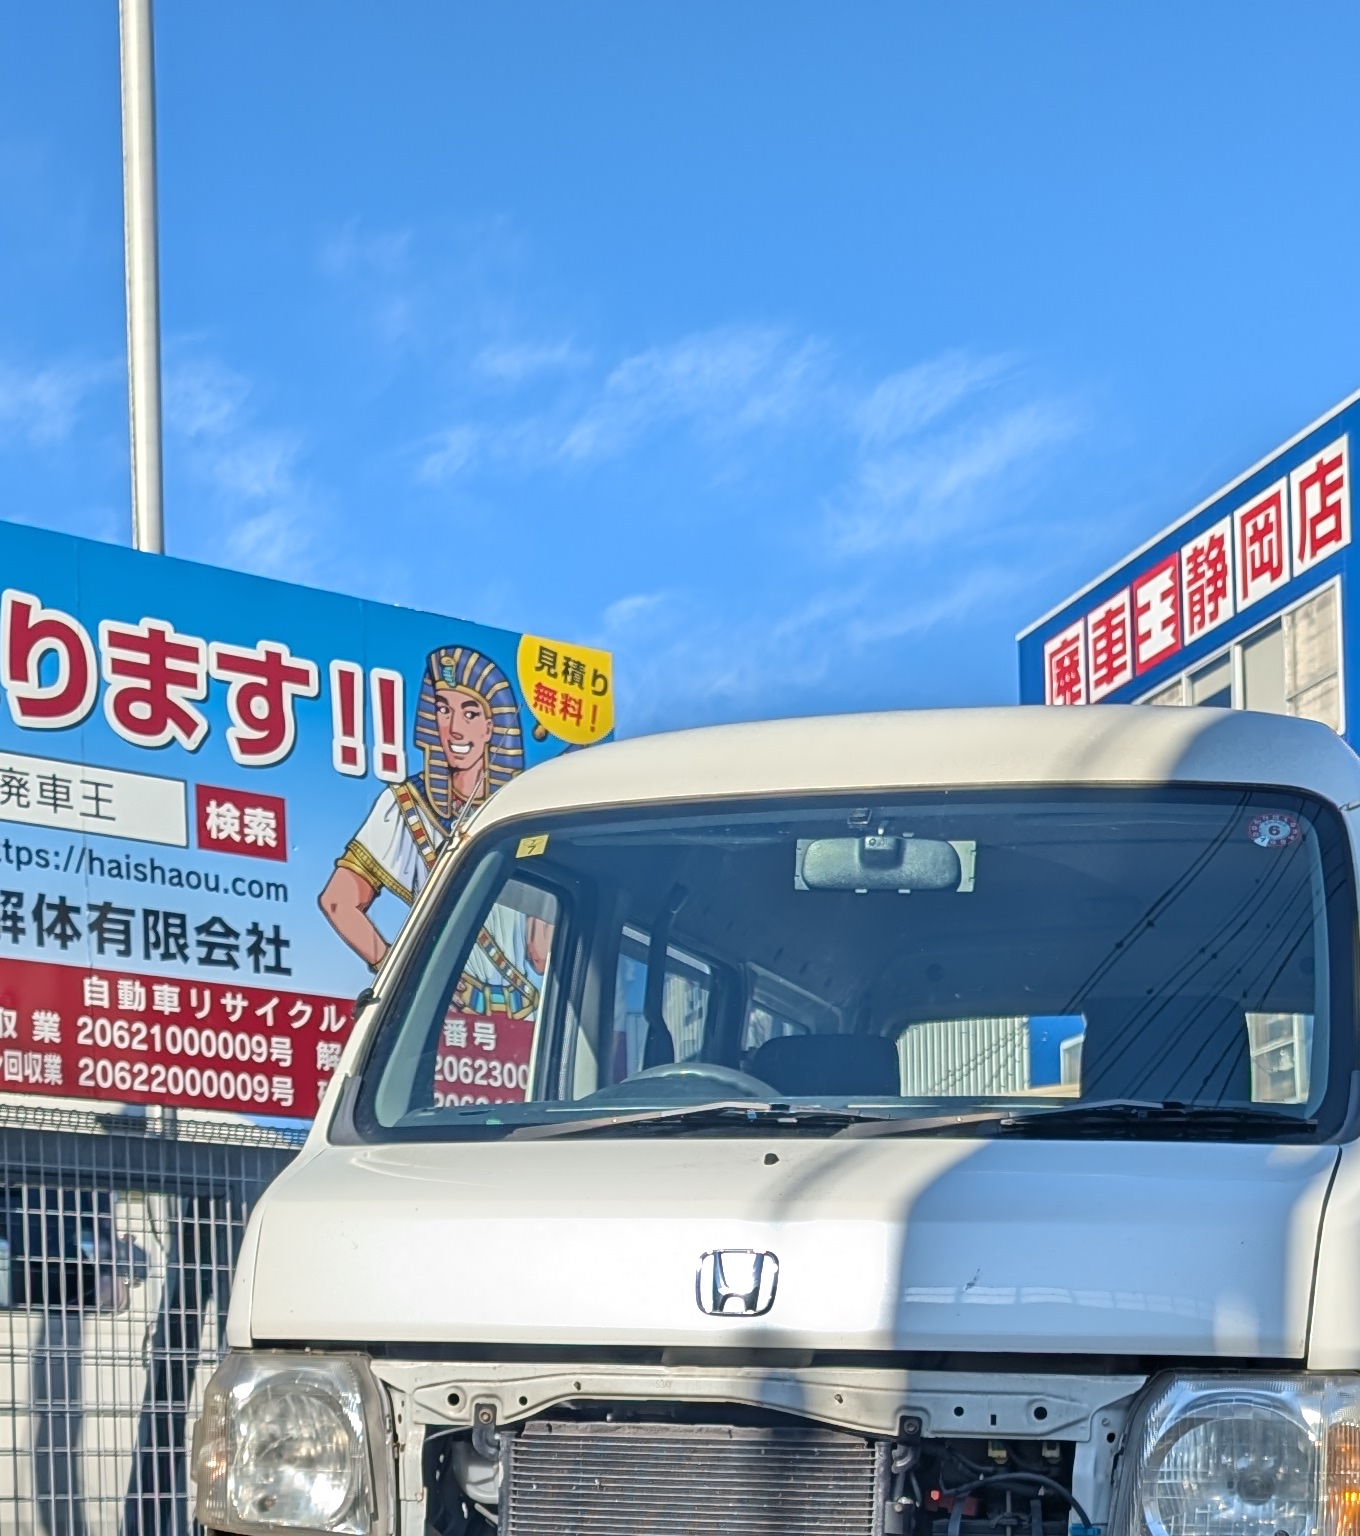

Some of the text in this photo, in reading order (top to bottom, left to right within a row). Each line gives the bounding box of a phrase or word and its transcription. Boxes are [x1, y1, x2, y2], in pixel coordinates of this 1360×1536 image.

[1048, 451, 1344, 704] 廃車王静岡店
[534, 645, 608, 697] 見積り
[533, 682, 600, 732] 無料！
[205, 799, 278, 848] 検索
[76, 1017, 293, 1068] 20621000009号
[443, 1019, 498, 1051] 番号
[77, 1057, 295, 1108] 20622000009号
